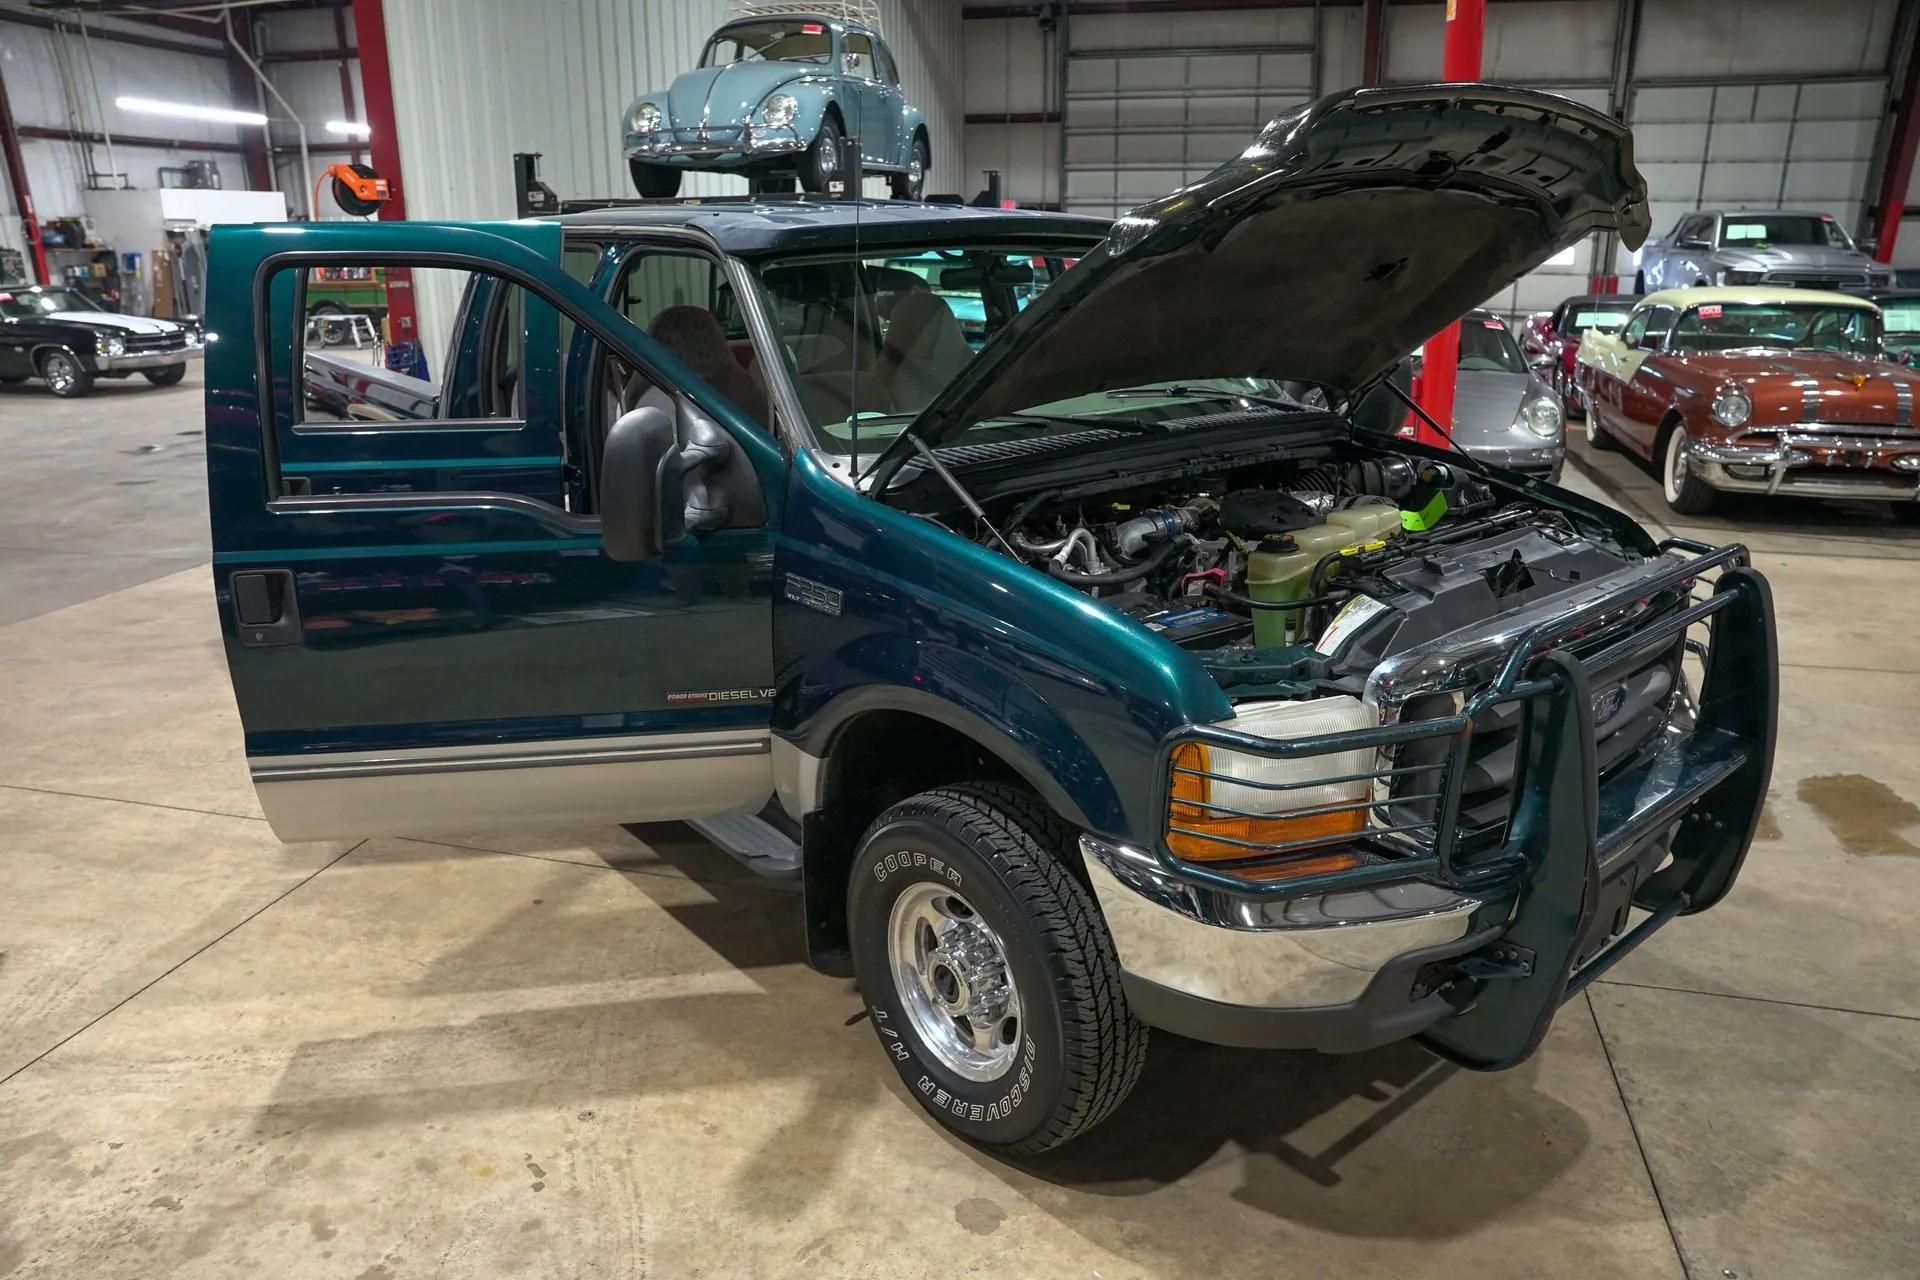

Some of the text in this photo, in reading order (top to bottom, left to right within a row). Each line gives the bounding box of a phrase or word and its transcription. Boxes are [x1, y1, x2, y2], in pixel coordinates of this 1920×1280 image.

[786, 592, 800, 601] XLT
[708, 689, 758, 701] DIESEL
[1597, 692, 1621, 721] Ford
[872, 850, 963, 888] COOPER
[872, 1005, 1036, 1122] DISCOVERER H/T
